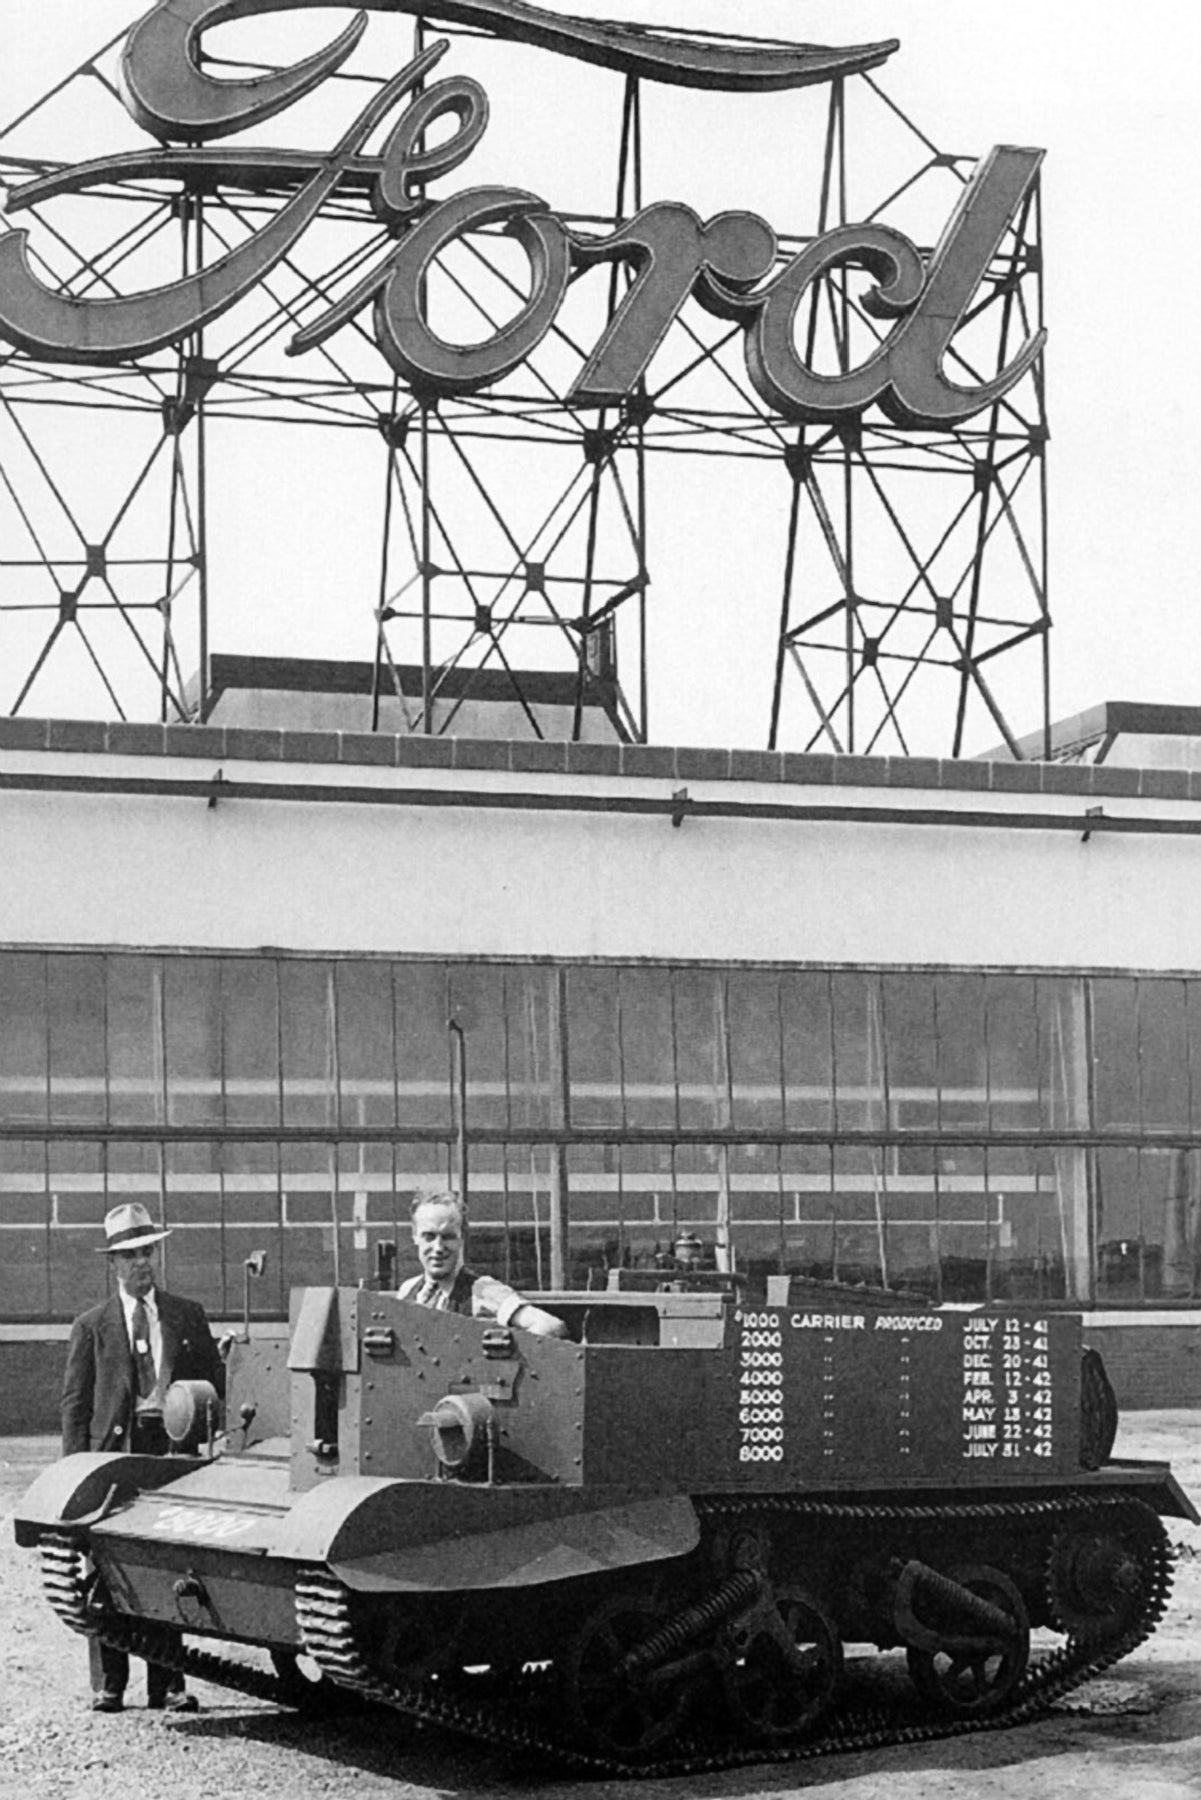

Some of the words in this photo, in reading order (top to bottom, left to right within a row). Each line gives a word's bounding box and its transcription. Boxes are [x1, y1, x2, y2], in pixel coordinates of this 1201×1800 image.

[0, 0, 1047, 430] Ford
[790, 1313, 866, 1329] CARRIER
[874, 1315, 943, 1331] PRODUCED
[962, 1317, 999, 1333] JULY
[741, 1330, 783, 1348] 2000
[739, 1350, 784, 1368] 3000
[739, 1370, 784, 1386] 4000
[739, 1388, 784, 1405] 5000
[739, 1407, 784, 1424] 6000
[962, 1407, 997, 1422] MAY
[739, 1426, 784, 1443] 7000
[962, 1423, 997, 1441] JUNE
[739, 1445, 784, 1462] 8000
[962, 1442, 999, 1458] JULY
